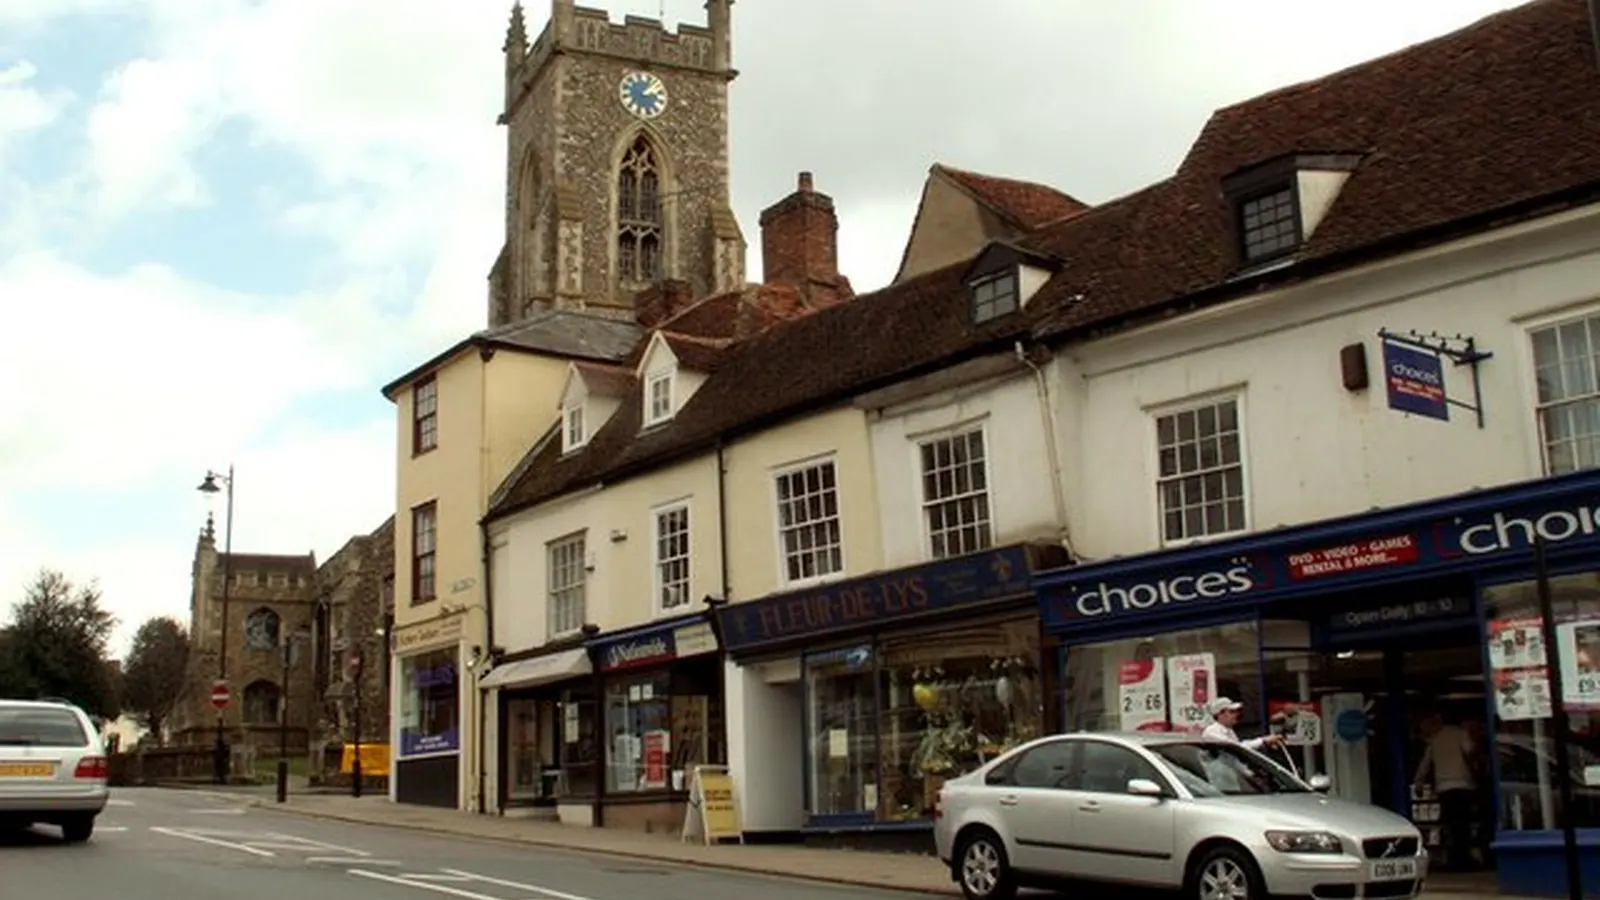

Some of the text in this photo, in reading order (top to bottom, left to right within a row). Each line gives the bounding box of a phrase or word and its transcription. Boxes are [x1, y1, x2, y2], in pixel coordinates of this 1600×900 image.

[1459, 507, 1600, 554] choi
[1289, 535, 1411, 566] DVD VIDEO GAMES
[1302, 560, 1343, 576] RENTAL
[1076, 566, 1252, 616] choices
[1344, 611, 1379, 627] Open
[1380, 604, 1410, 620] Daily
[1124, 696, 1132, 712] 2
